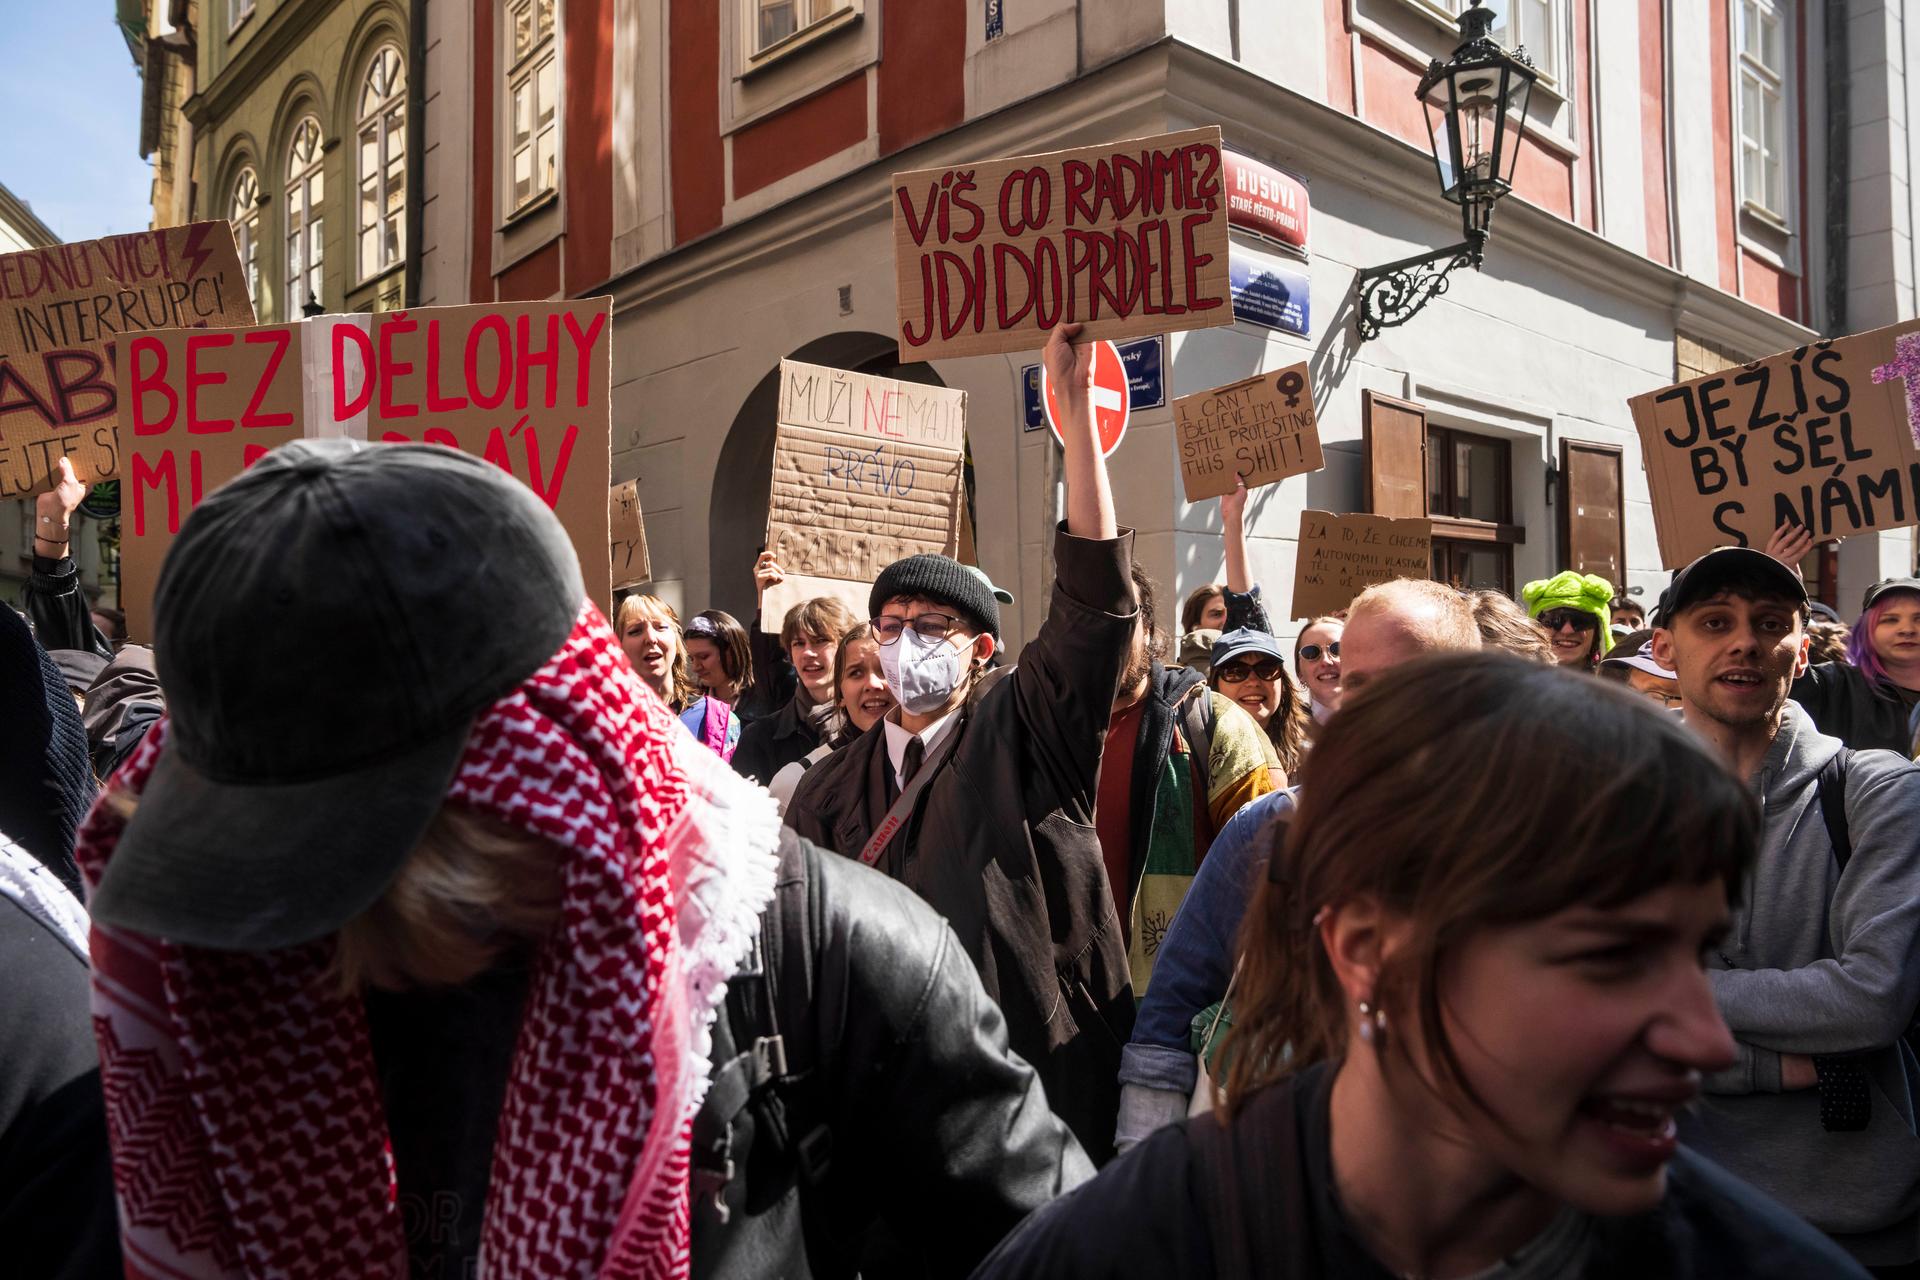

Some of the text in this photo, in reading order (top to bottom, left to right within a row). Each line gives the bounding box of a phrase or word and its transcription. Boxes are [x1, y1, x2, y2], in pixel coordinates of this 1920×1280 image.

[898, 170, 985, 247] VÍŠ
[998, 166, 1051, 237] CO
[1230, 194, 1252, 214] STARÉ
[1236, 167, 1296, 212] HUSOVA
[903, 212, 1223, 347] JDI DO PRDELE
[129, 310, 607, 437] BEZ DĚLOHY
[1655, 341, 1851, 449] JEŽÍŠ
[789, 372, 853, 428] MUŽI
[1179, 388, 1254, 422] I CAN'T
[1181, 400, 1278, 440] BELIEVE I'M
[1183, 407, 1314, 458] STILL PROTESTING
[1690, 412, 1872, 495] BY ŠEL
[823, 445, 916, 497] PRÁVO
[1183, 454, 1224, 477] THIS
[1307, 522, 1327, 540] ZA
[1363, 526, 1382, 545] ŽE
[1712, 500, 1749, 548] S
[1314, 547, 1378, 565] AUTONOMII
[863, 815, 899, 862] Canon
